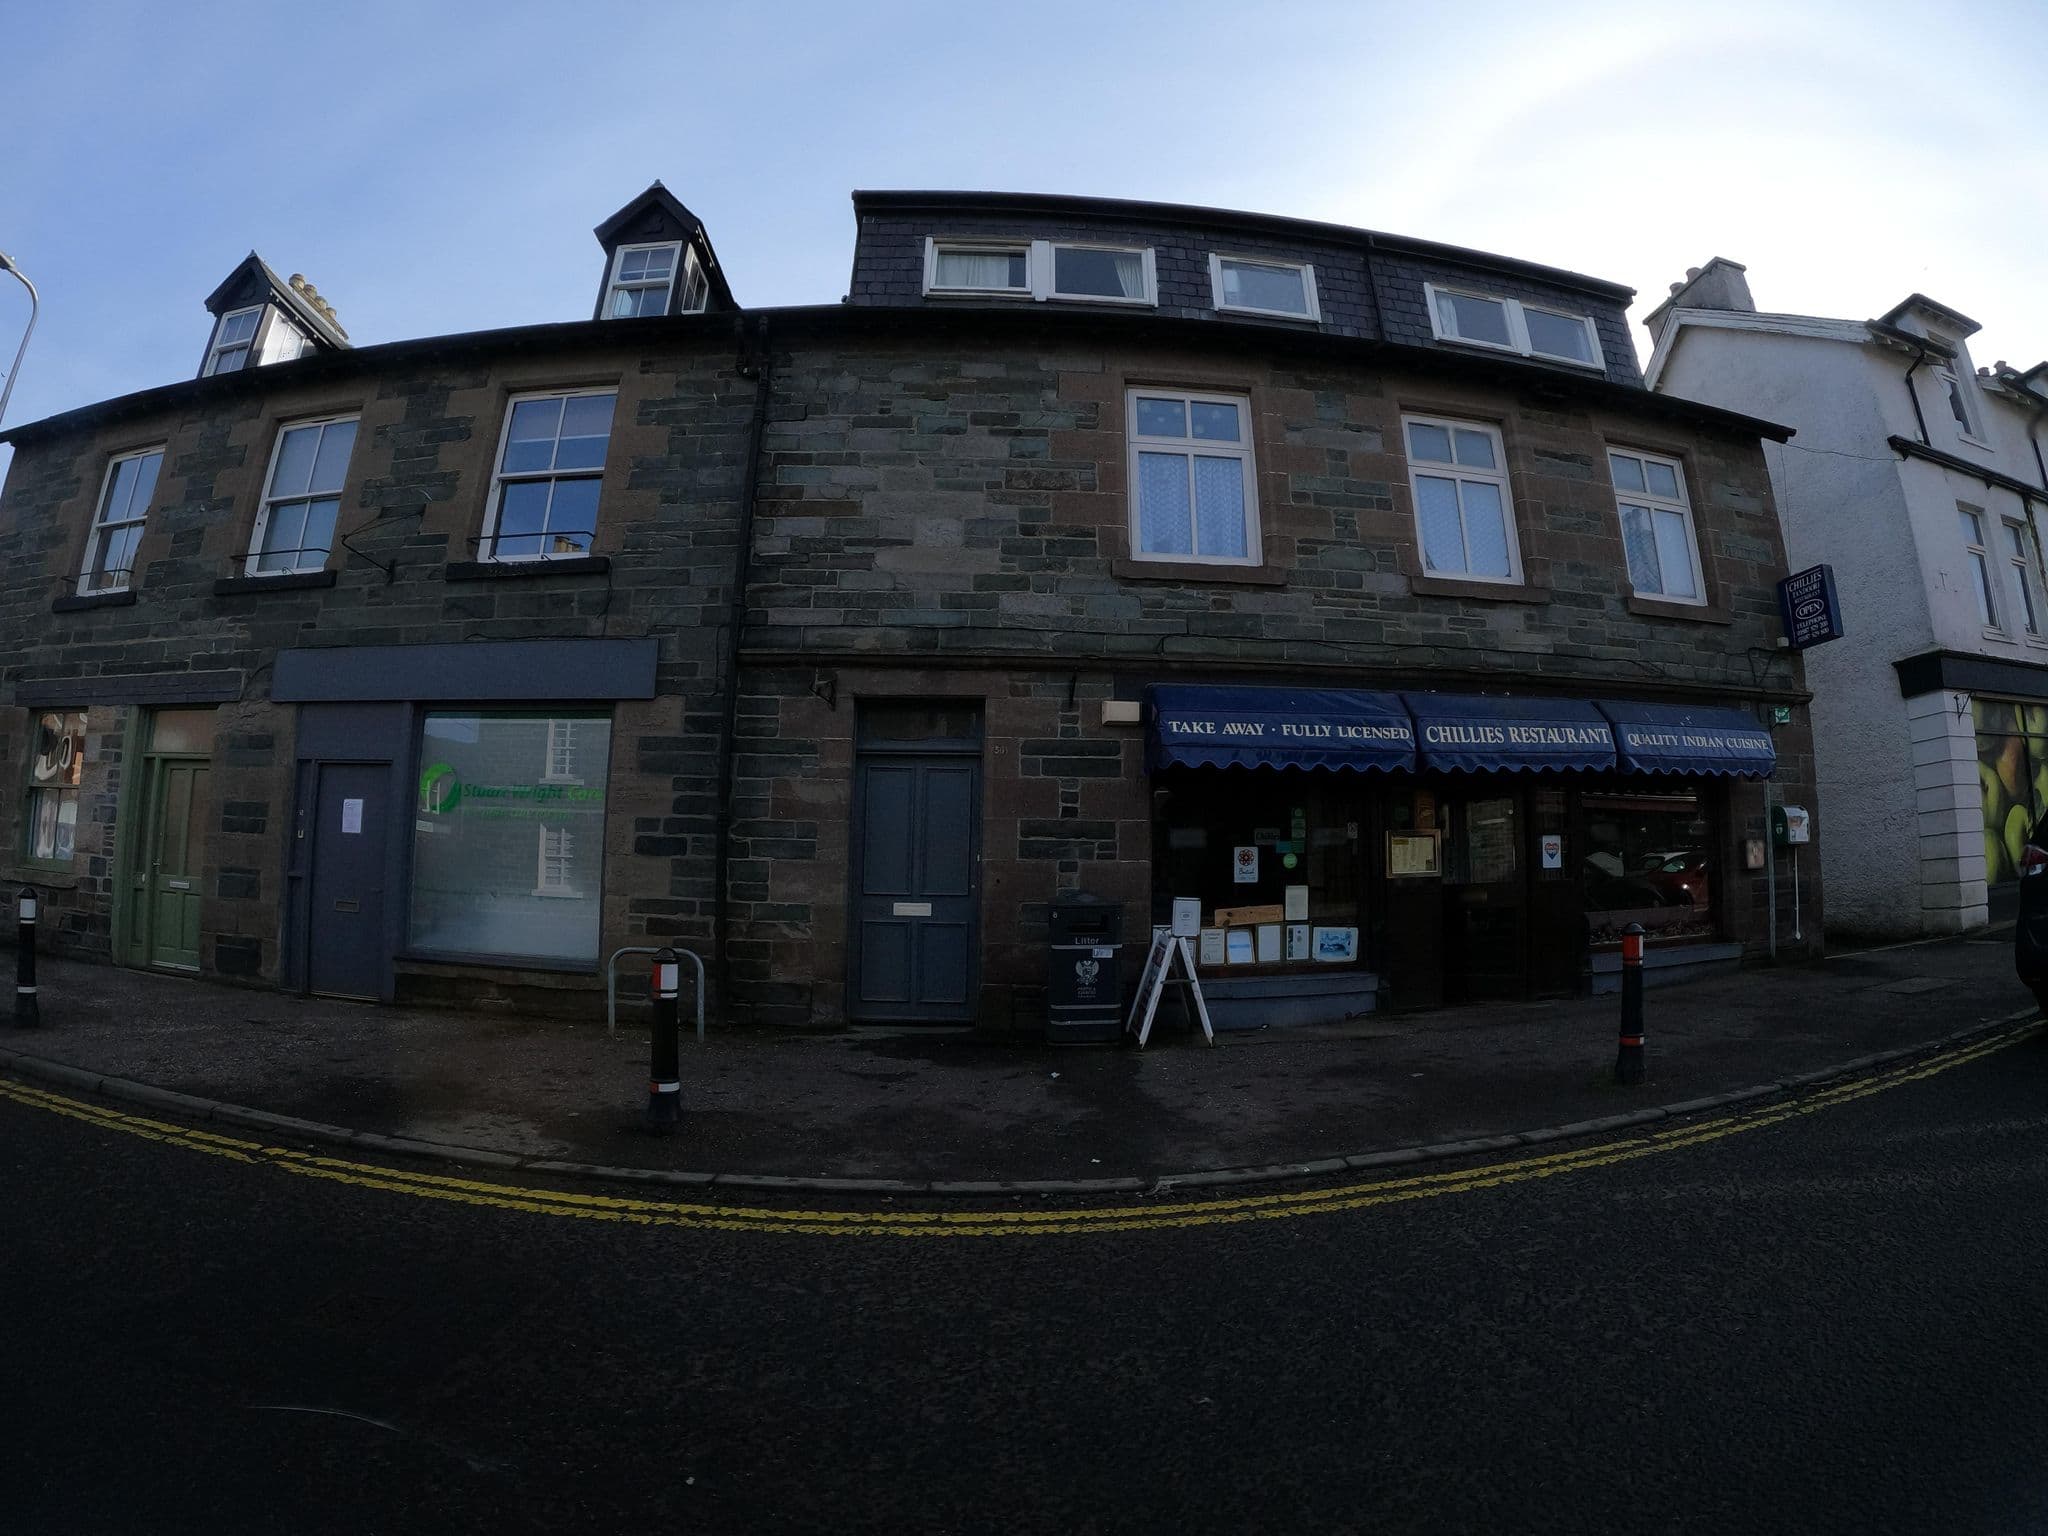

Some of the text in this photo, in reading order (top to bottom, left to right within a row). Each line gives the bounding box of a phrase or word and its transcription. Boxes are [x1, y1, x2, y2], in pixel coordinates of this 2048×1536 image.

[1789, 572, 1821, 592] CHILLIES
[1799, 602, 1820, 616] OPEN
[1168, 720, 1410, 740] TAKE AWAY FULLY LICENSED
[1426, 726, 1611, 744] CHILLIES RESTAURANT
[1628, 733, 1769, 750] QUALITY INDIAN CUISINE
